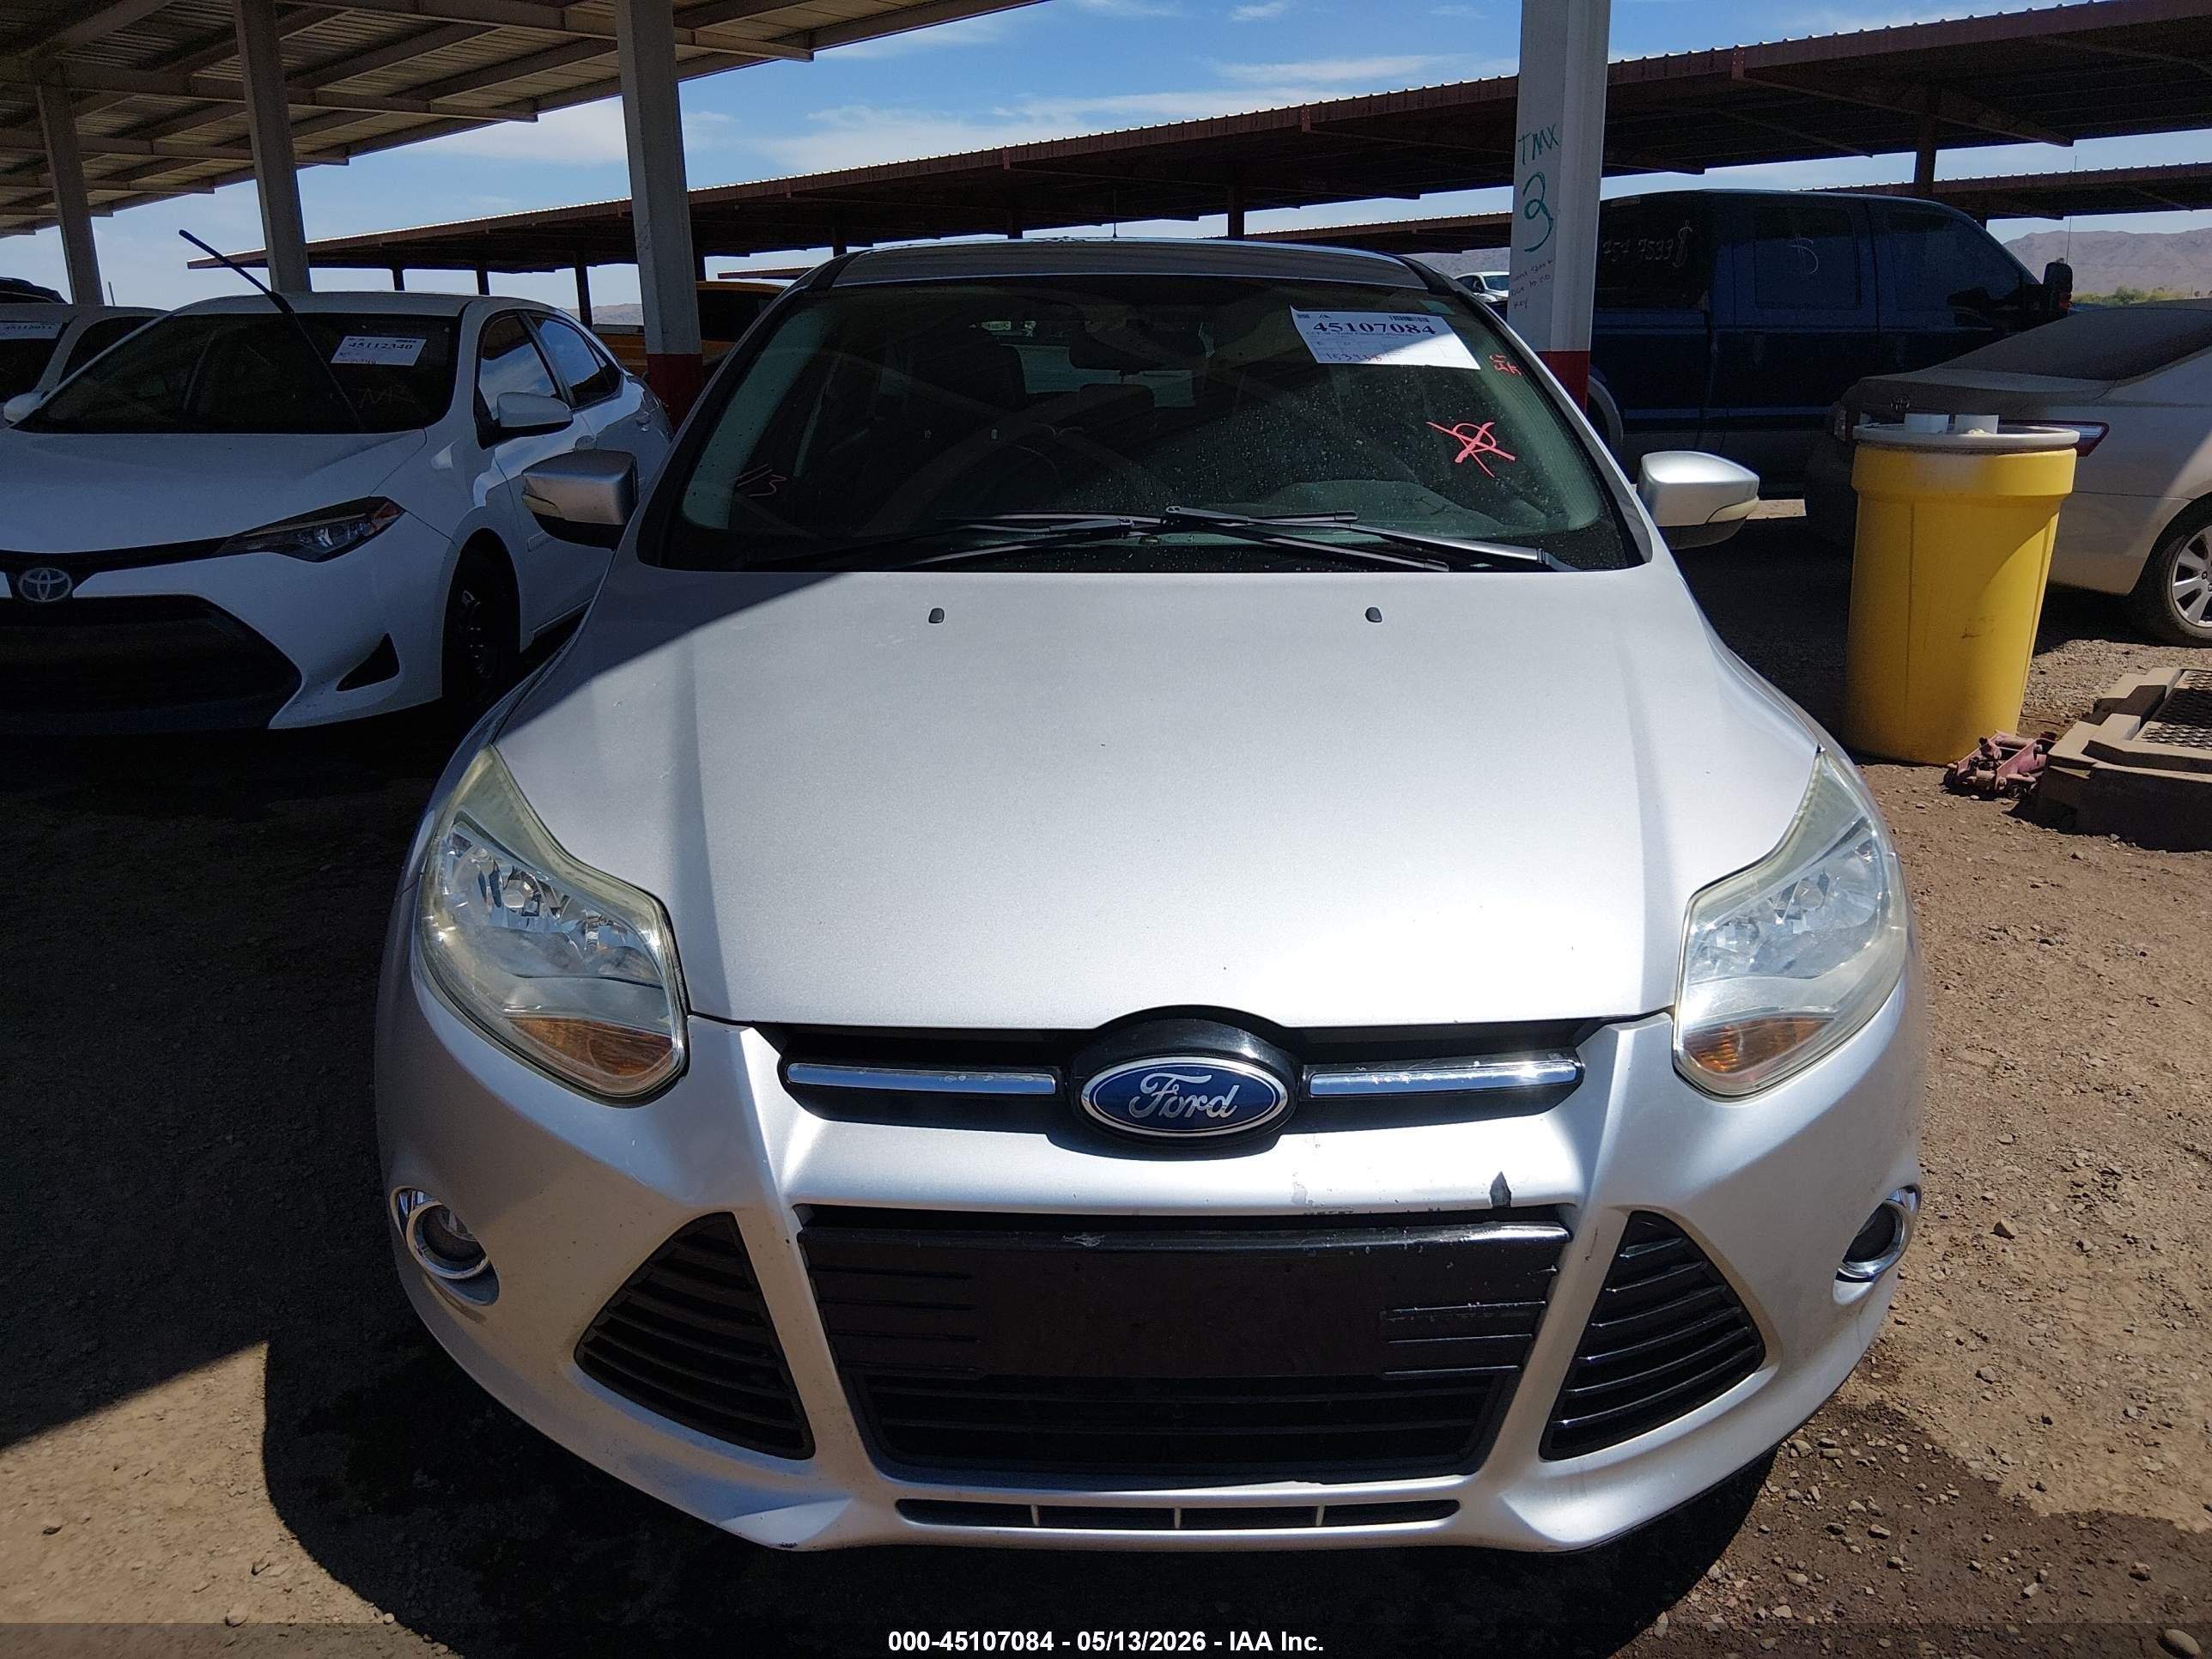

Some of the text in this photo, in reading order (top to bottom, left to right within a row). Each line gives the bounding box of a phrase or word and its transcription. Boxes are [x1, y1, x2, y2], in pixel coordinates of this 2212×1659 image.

[1518, 124, 1559, 165] TMX
[1313, 321, 1437, 335] 45107084
[1129, 1073, 1240, 1118] Ford
